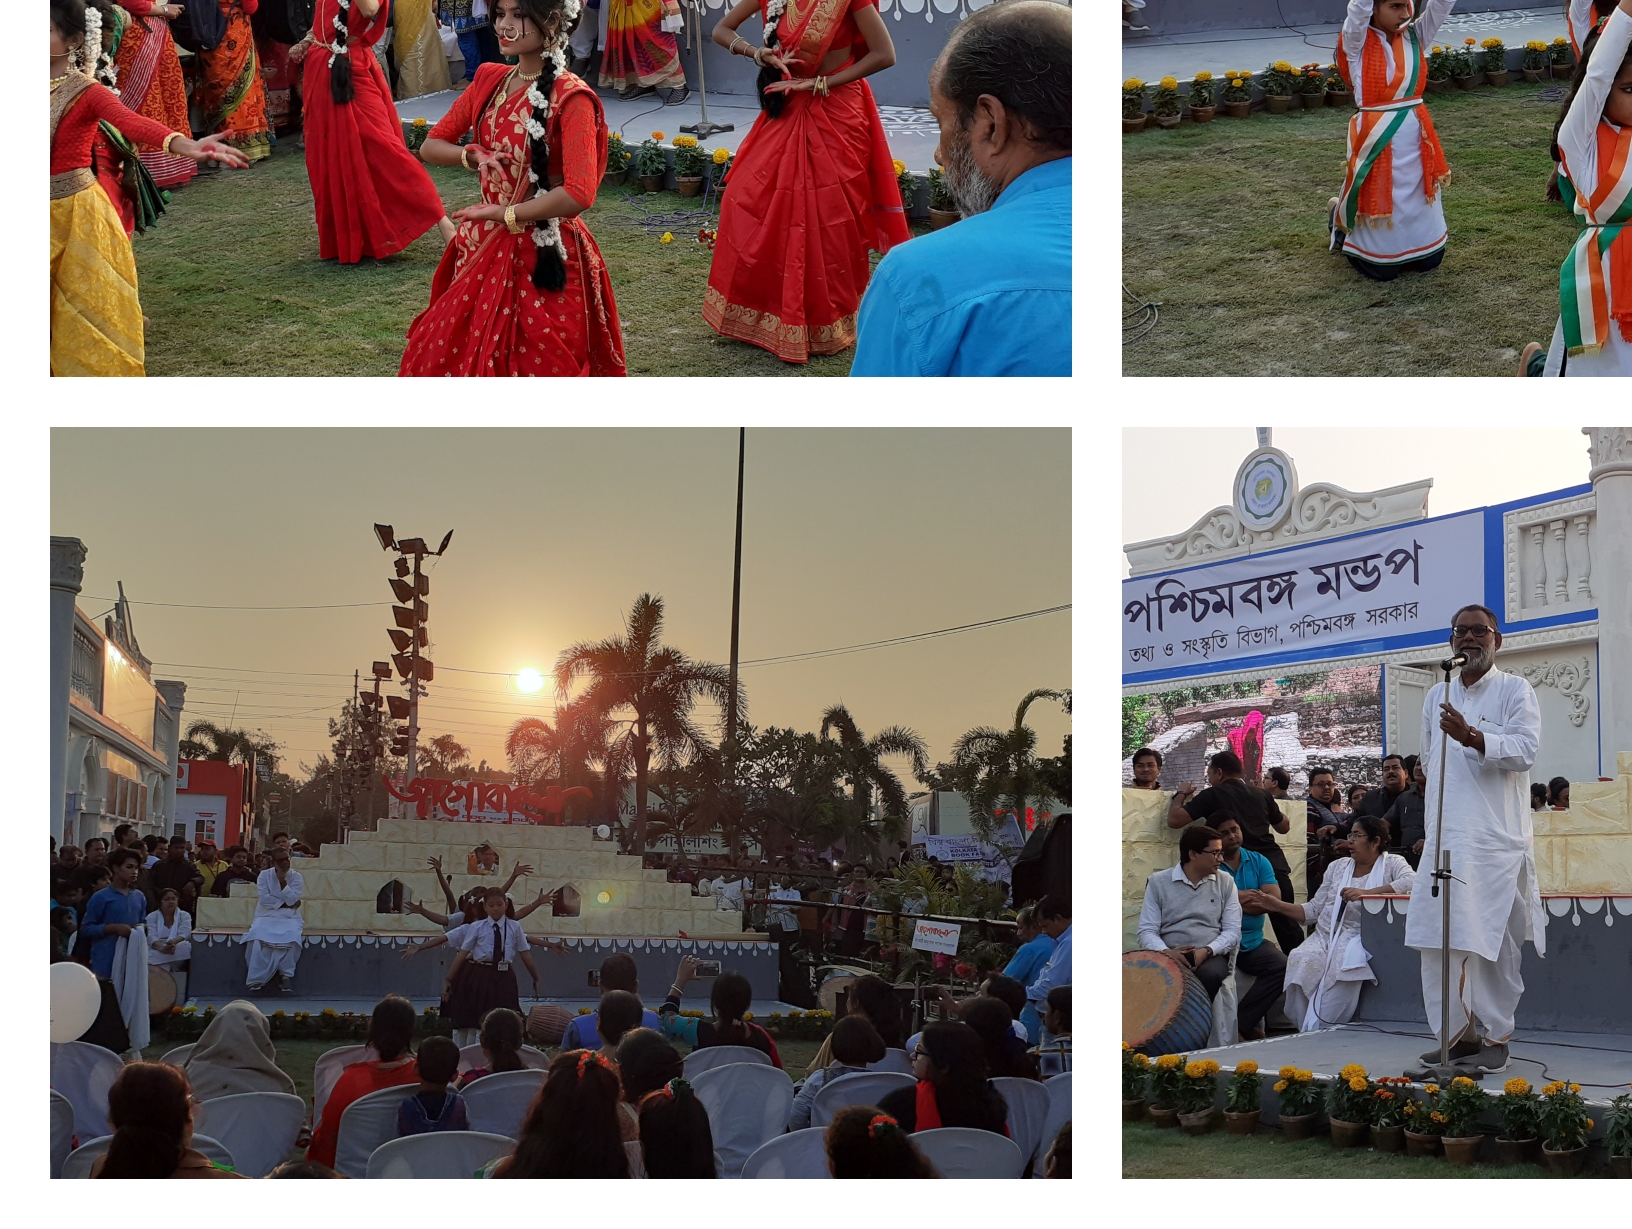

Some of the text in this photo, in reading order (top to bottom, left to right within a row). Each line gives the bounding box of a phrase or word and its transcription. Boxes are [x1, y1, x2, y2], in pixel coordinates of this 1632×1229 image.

[1124, 571, 1299, 633] পশ্চিমবঙ্গ
[1129, 601, 1419, 662] তথ্য ও সংস্কৃতি বিভাগ, পশ্চিমবঙ্গ সরকার
